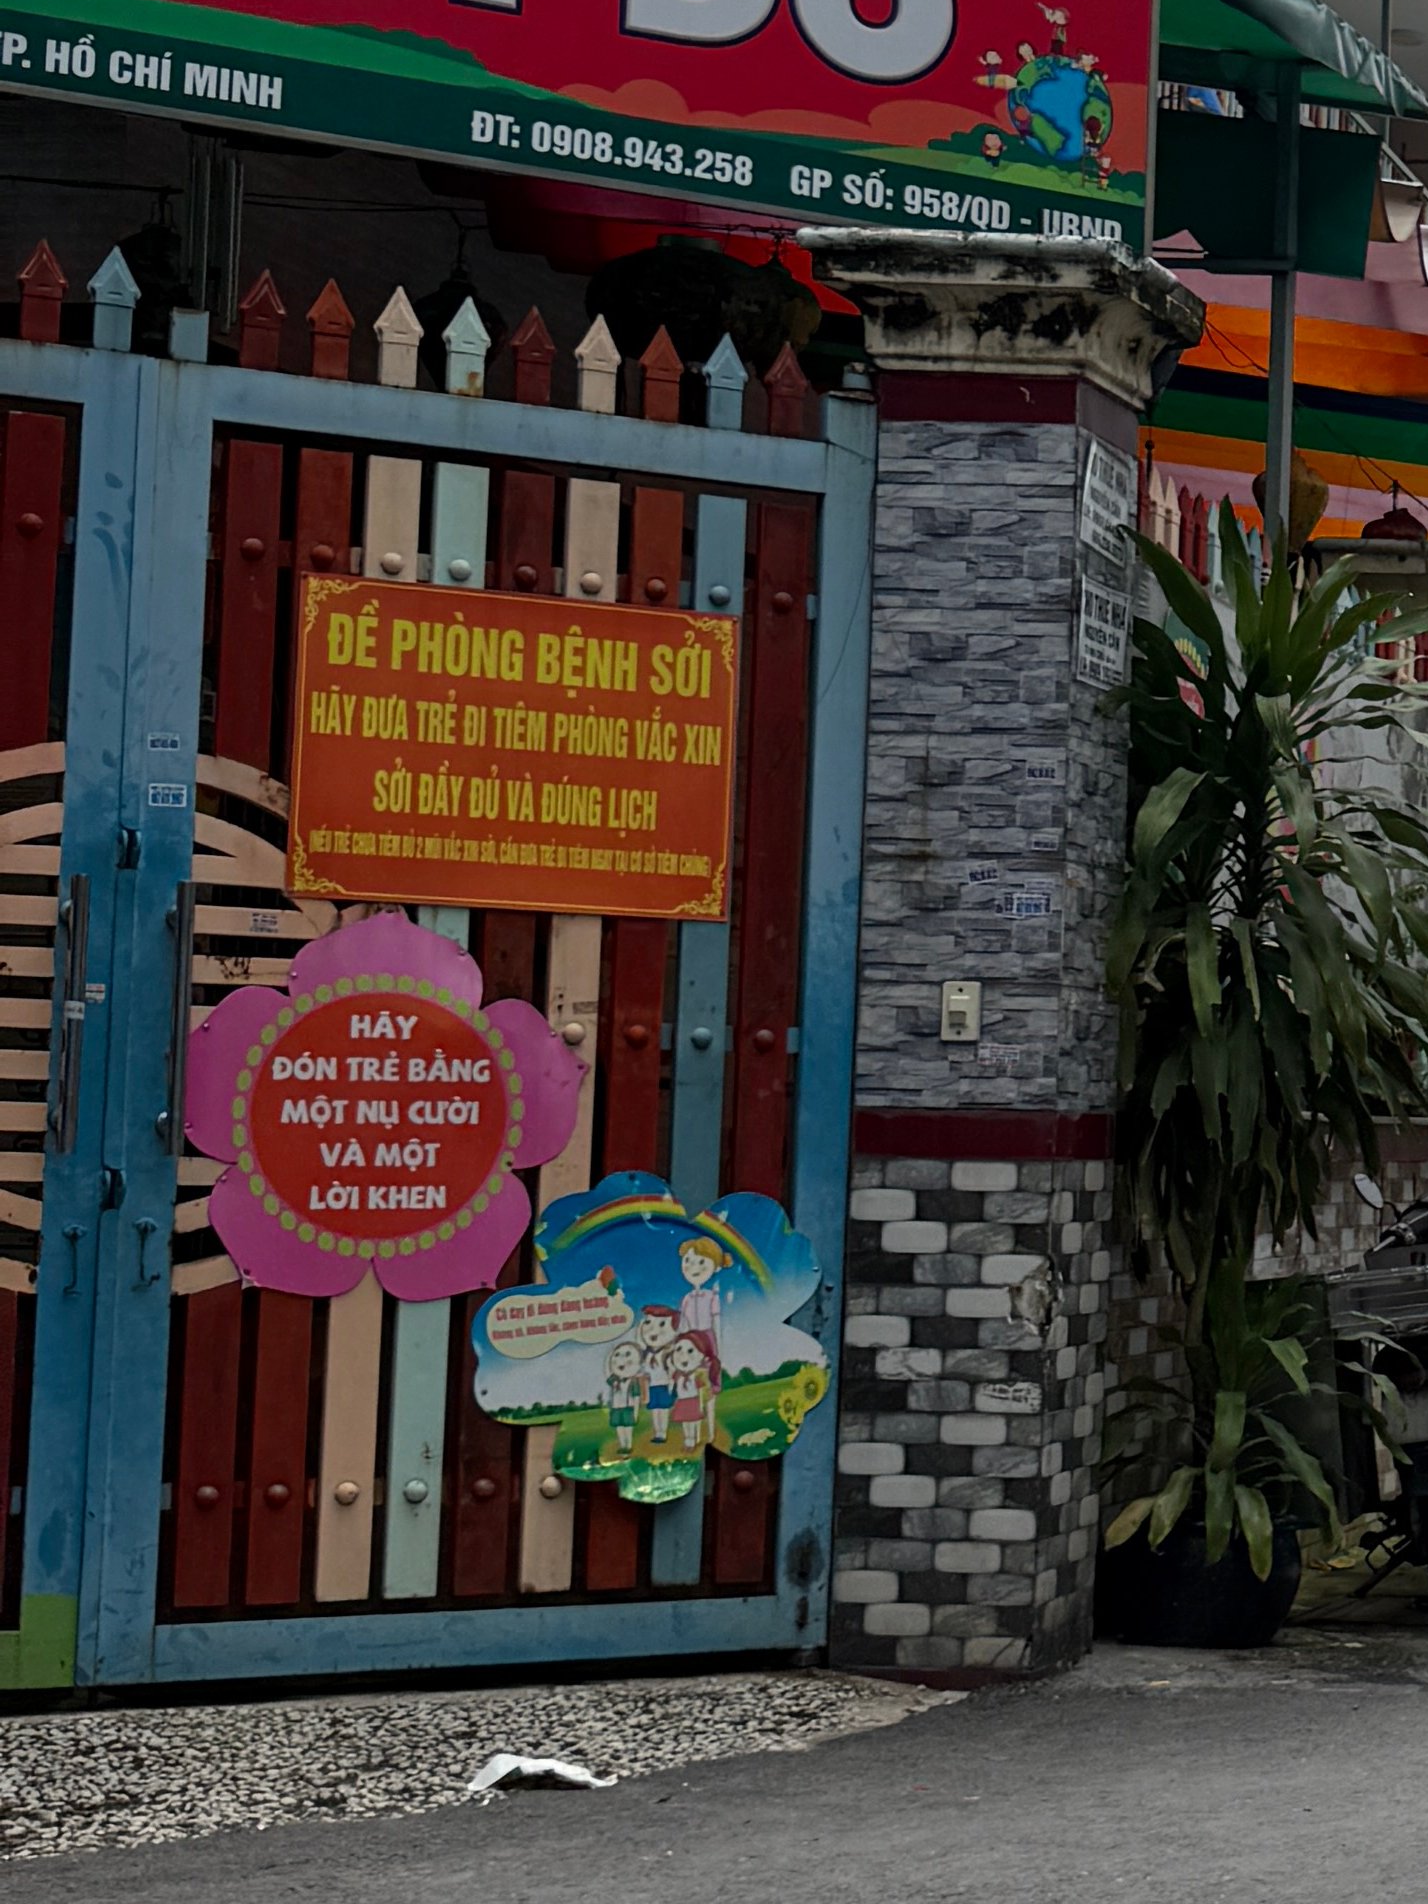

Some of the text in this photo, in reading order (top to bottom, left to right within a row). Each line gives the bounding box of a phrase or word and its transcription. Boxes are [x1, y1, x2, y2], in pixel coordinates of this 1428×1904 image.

[0, 32, 283, 110] P. HỒ CHÍ MINH
[471, 110, 521, 148] ĐT:
[531, 121, 754, 187] 0908.943.258
[789, 165, 833, 198] GP
[842, 168, 894, 211] SỐ:
[328, 598, 712, 699] ĐỀ PHÒNG BỆNH SỞI
[310, 684, 722, 766] HÃY ĐƯA TRẺ ĐI TIÊM PHÒNG VẮC XIN
[373, 757, 658, 838] SỞI ĐẦY ĐỦ VÀ ĐÚNG LỊCH
[350, 1010, 419, 1040] HÃY
[271, 1048, 491, 1083] ĐÓN TRẺ BẰNG
[280, 1095, 480, 1130] MỘT NỤ CƯỜI
[320, 1138, 441, 1172] VÀ MỘT
[309, 1180, 447, 1210] LỜI KHEN
